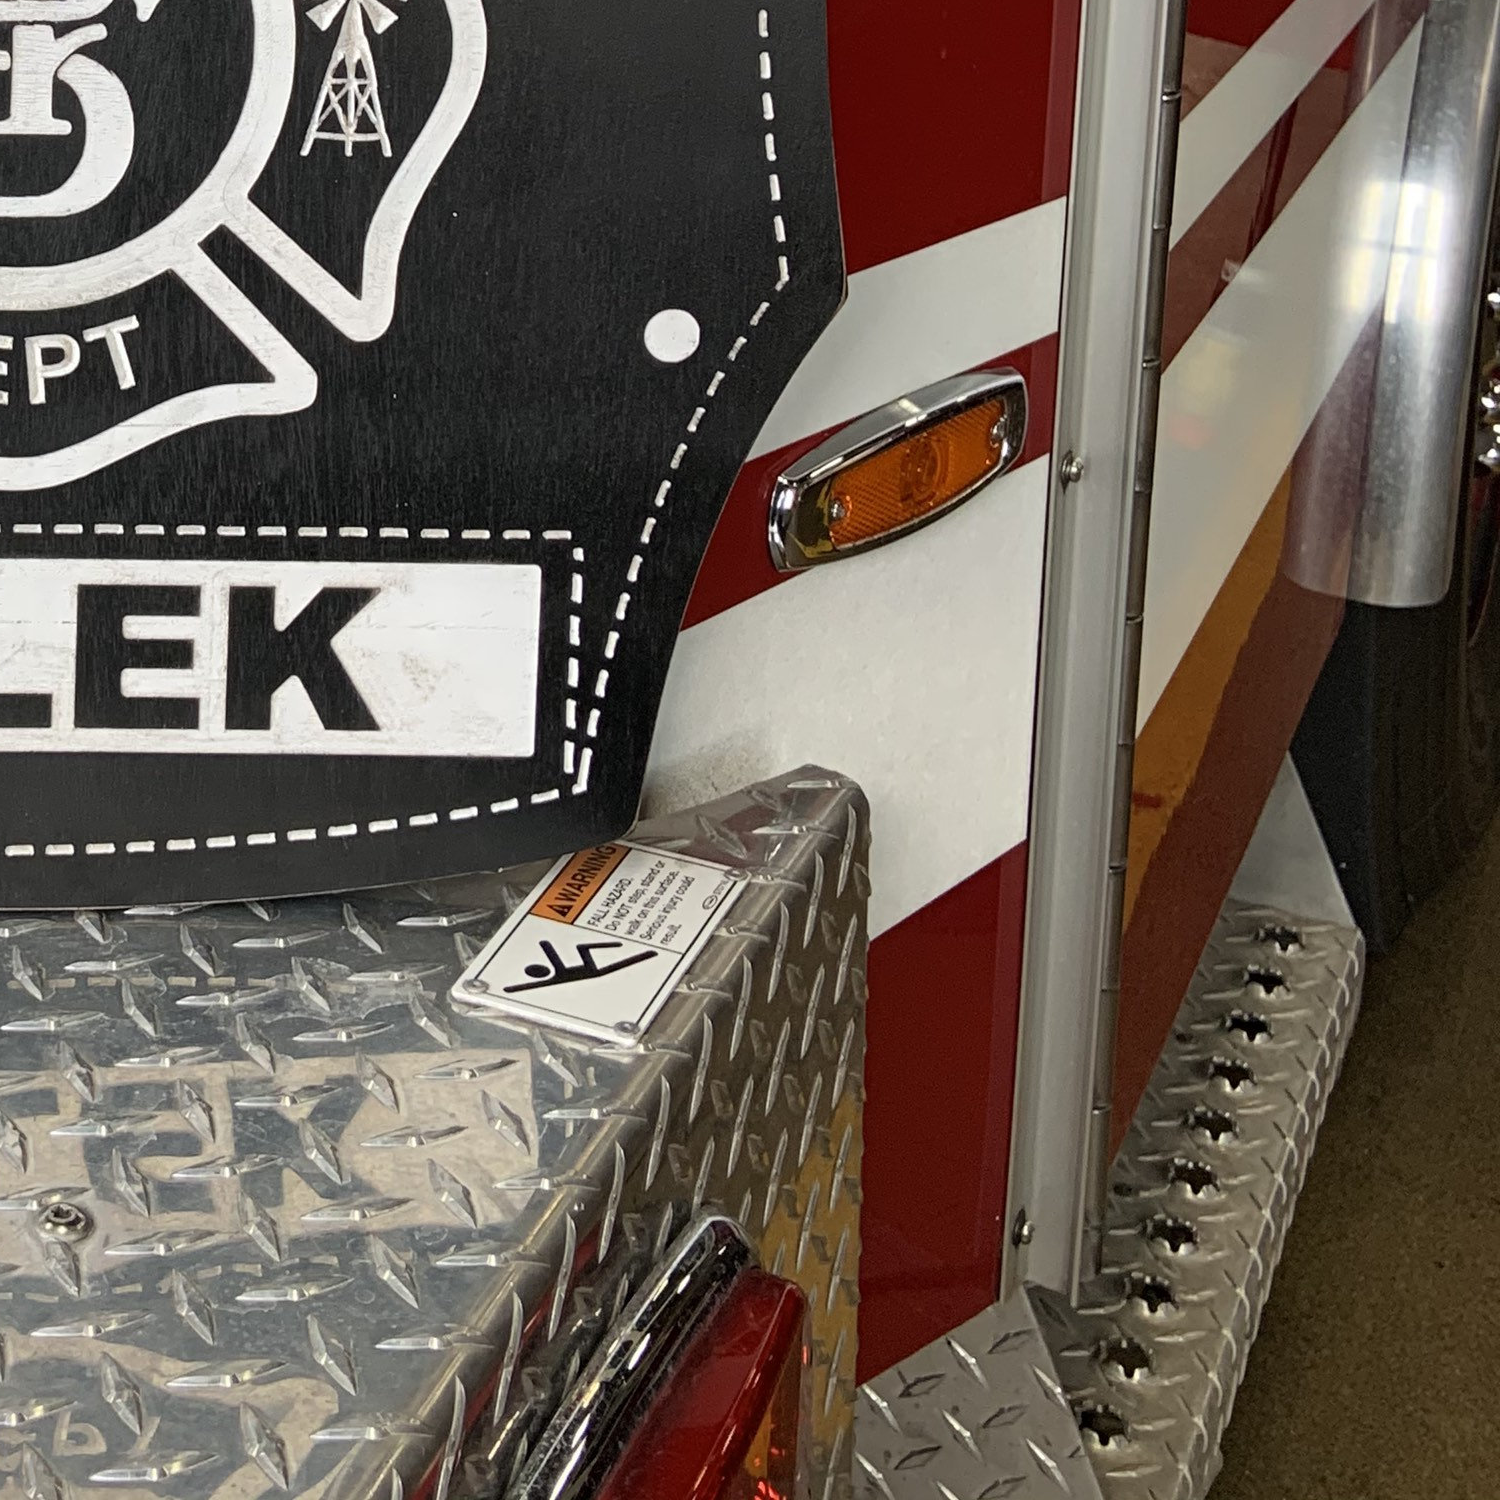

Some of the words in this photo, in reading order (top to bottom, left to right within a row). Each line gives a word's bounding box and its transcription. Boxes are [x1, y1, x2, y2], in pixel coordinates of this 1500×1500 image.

[558, 845, 617, 905] WARNING
[604, 920, 621, 932] Do
[613, 903, 632, 920] NOT
[640, 867, 660, 887] stand
[655, 860, 665, 869] or
[643, 895, 660, 909] this
[637, 909, 650, 919] on
[639, 914, 668, 941] Serious
[661, 894, 683, 914] injury
[676, 875, 696, 895] could
[587, 909, 610, 927] FALL
[624, 919, 643, 936] walk
